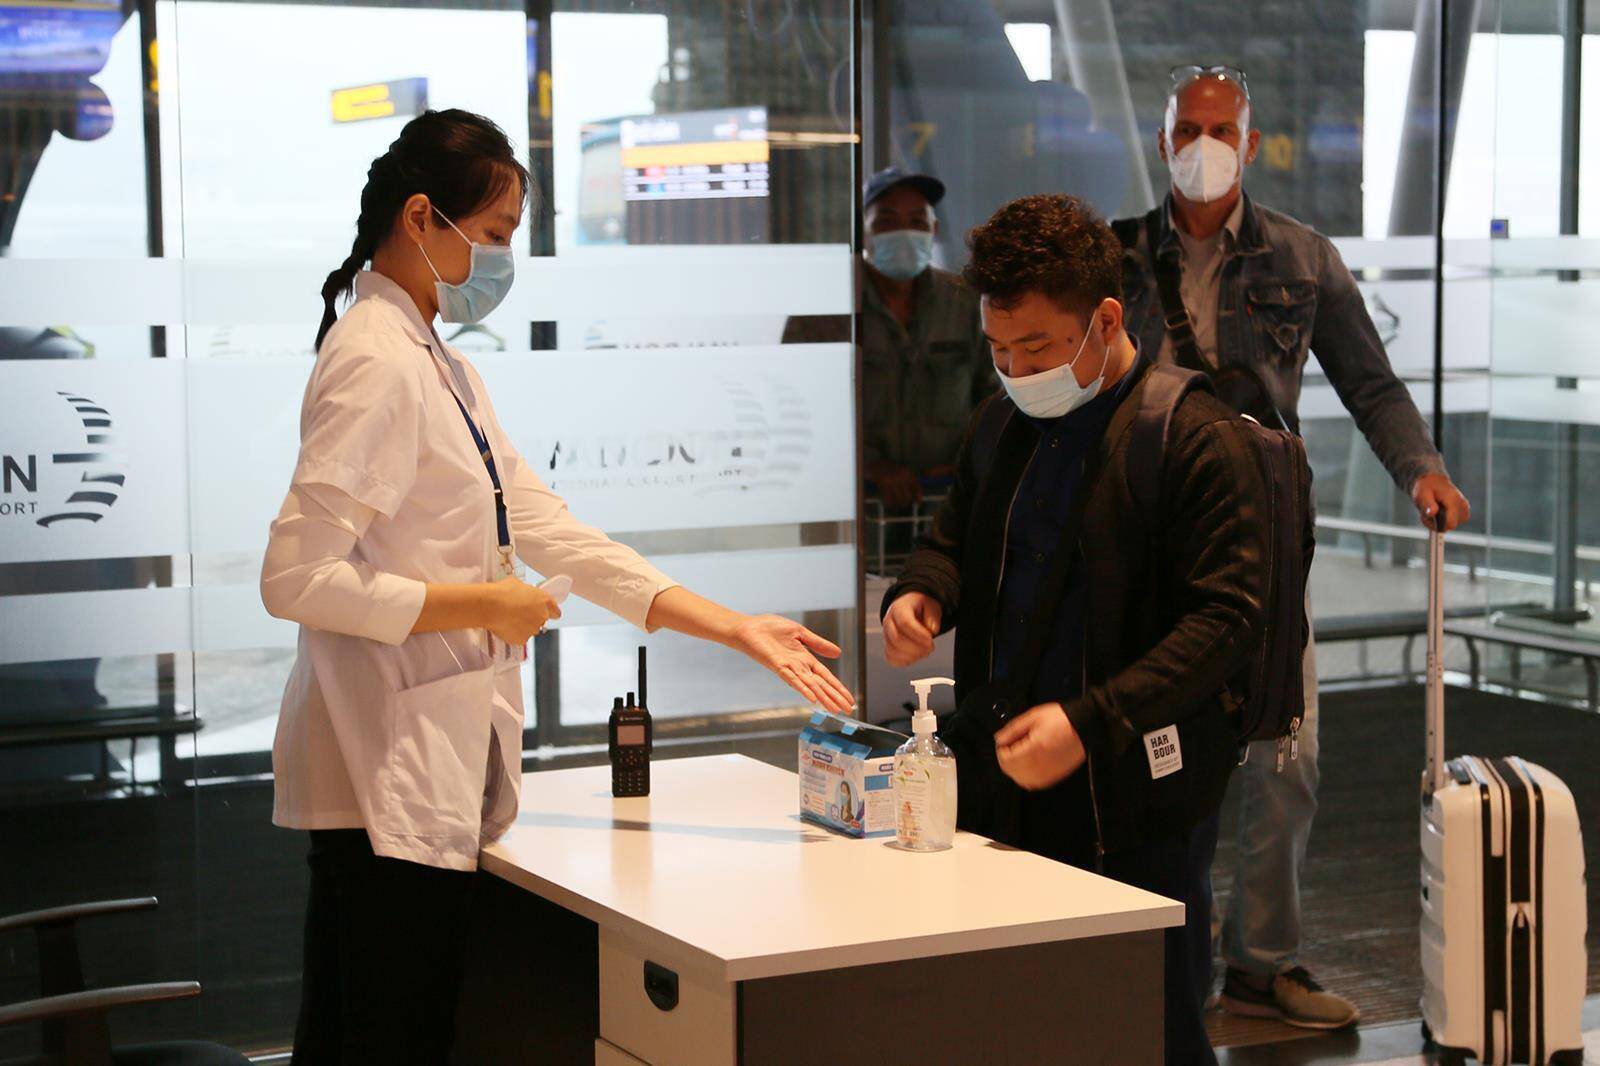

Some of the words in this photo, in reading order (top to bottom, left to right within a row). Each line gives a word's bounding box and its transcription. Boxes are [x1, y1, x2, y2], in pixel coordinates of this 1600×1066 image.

[3, 455, 37, 493] N
[0, 502, 37, 515] ORT
[1150, 734, 1169, 748] HAR
[1153, 744, 1175, 759] BOUR
